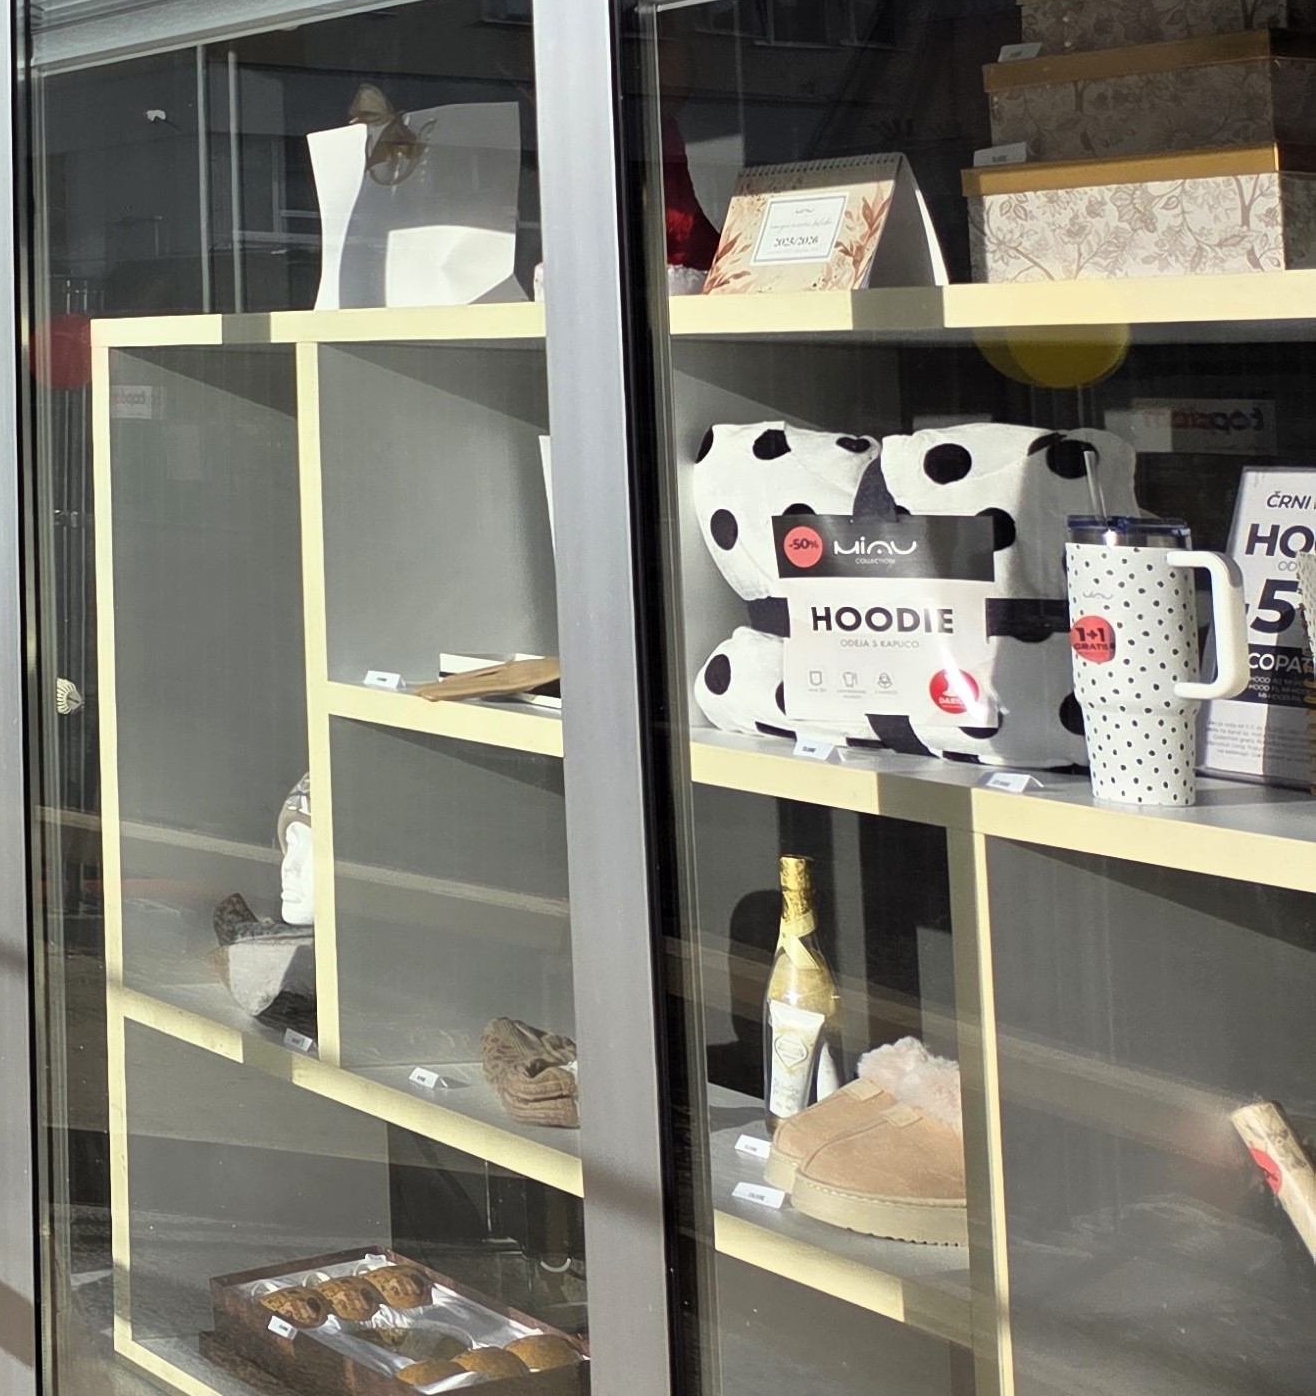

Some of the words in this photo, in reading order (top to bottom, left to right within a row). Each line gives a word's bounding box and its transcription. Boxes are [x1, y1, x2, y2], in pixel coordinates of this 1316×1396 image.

[788, 539, 819, 551] -50%
[1244, 523, 1316, 558] HO
[811, 606, 954, 634] HOODIE
[1075, 626, 1106, 642] 1+1
